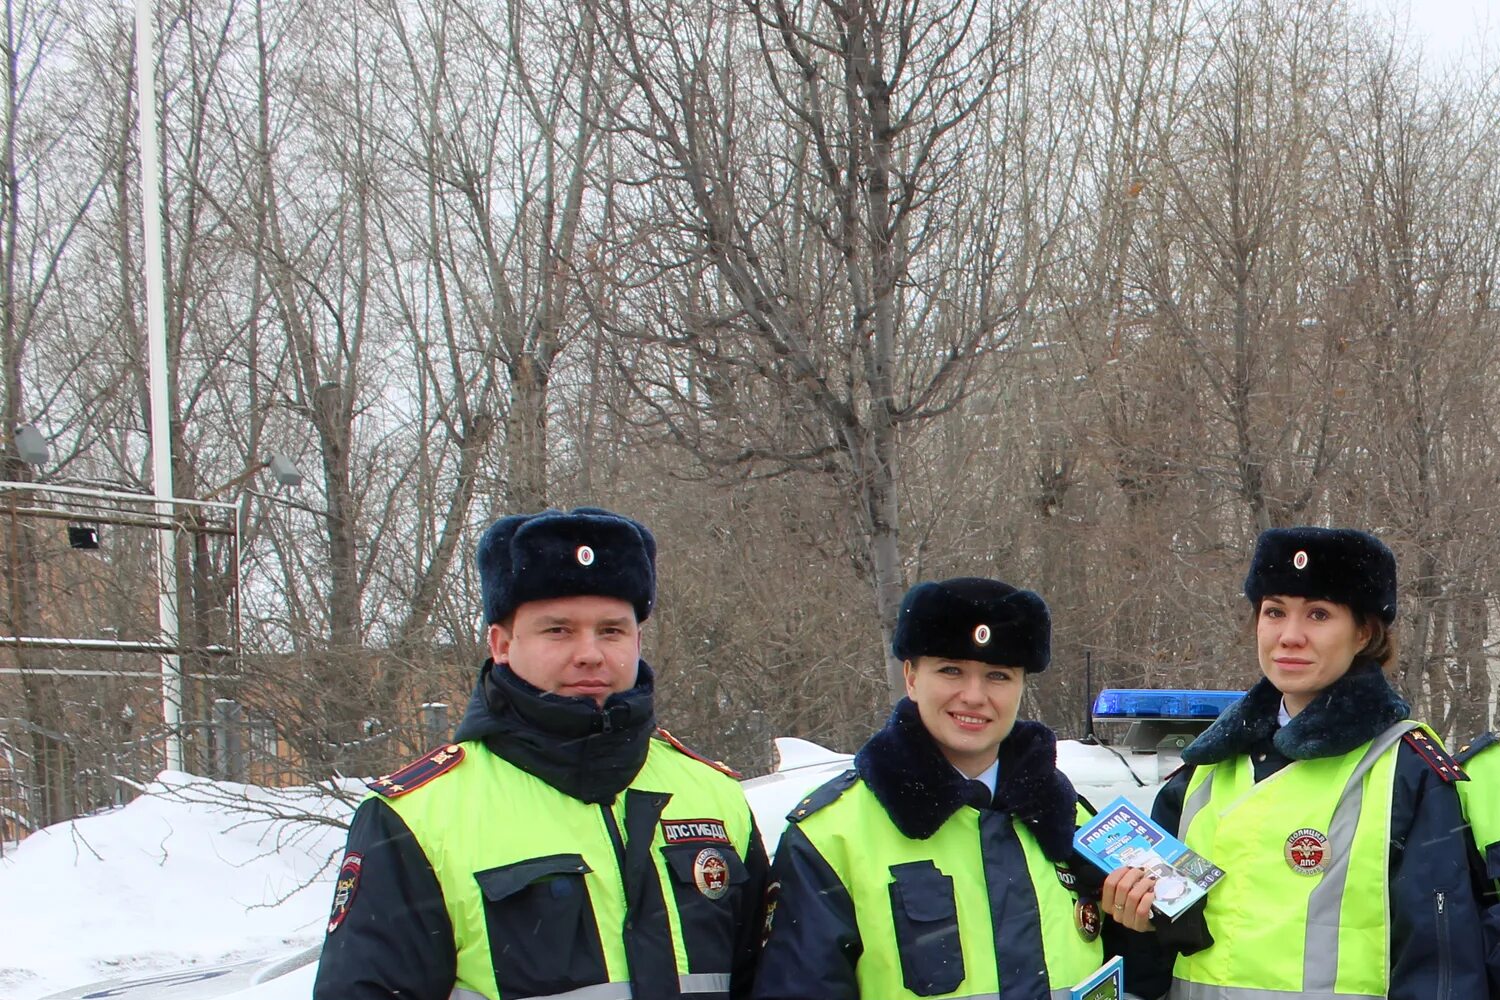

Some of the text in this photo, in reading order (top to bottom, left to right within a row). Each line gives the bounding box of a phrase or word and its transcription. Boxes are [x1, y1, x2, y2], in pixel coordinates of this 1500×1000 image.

[665, 823, 727, 840] ДПС ГИБДД
[1289, 829, 1325, 843] ПОЛИЦИЯ
[1300, 859, 1316, 867] ДПС
